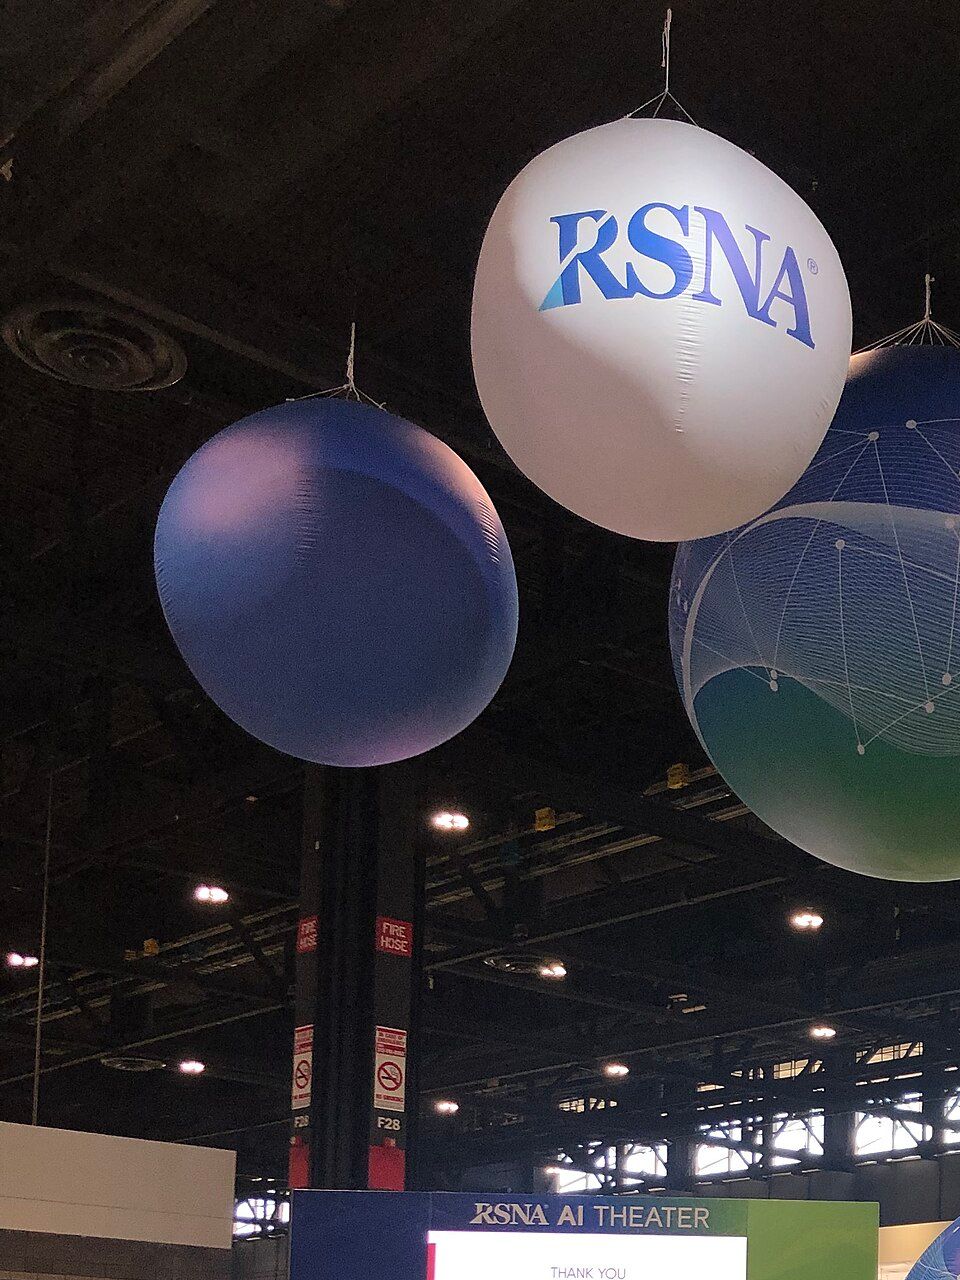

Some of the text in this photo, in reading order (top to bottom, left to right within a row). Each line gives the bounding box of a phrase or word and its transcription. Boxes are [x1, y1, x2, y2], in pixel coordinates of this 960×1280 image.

[539, 202, 815, 349] RSNA
[383, 922, 406, 938] FIRE
[380, 935, 408, 952] HOSE
[377, 1117, 400, 1130] F28
[469, 1203, 709, 1228] RSNA AI THEATER
[551, 1267, 626, 1279] THANK YOU
